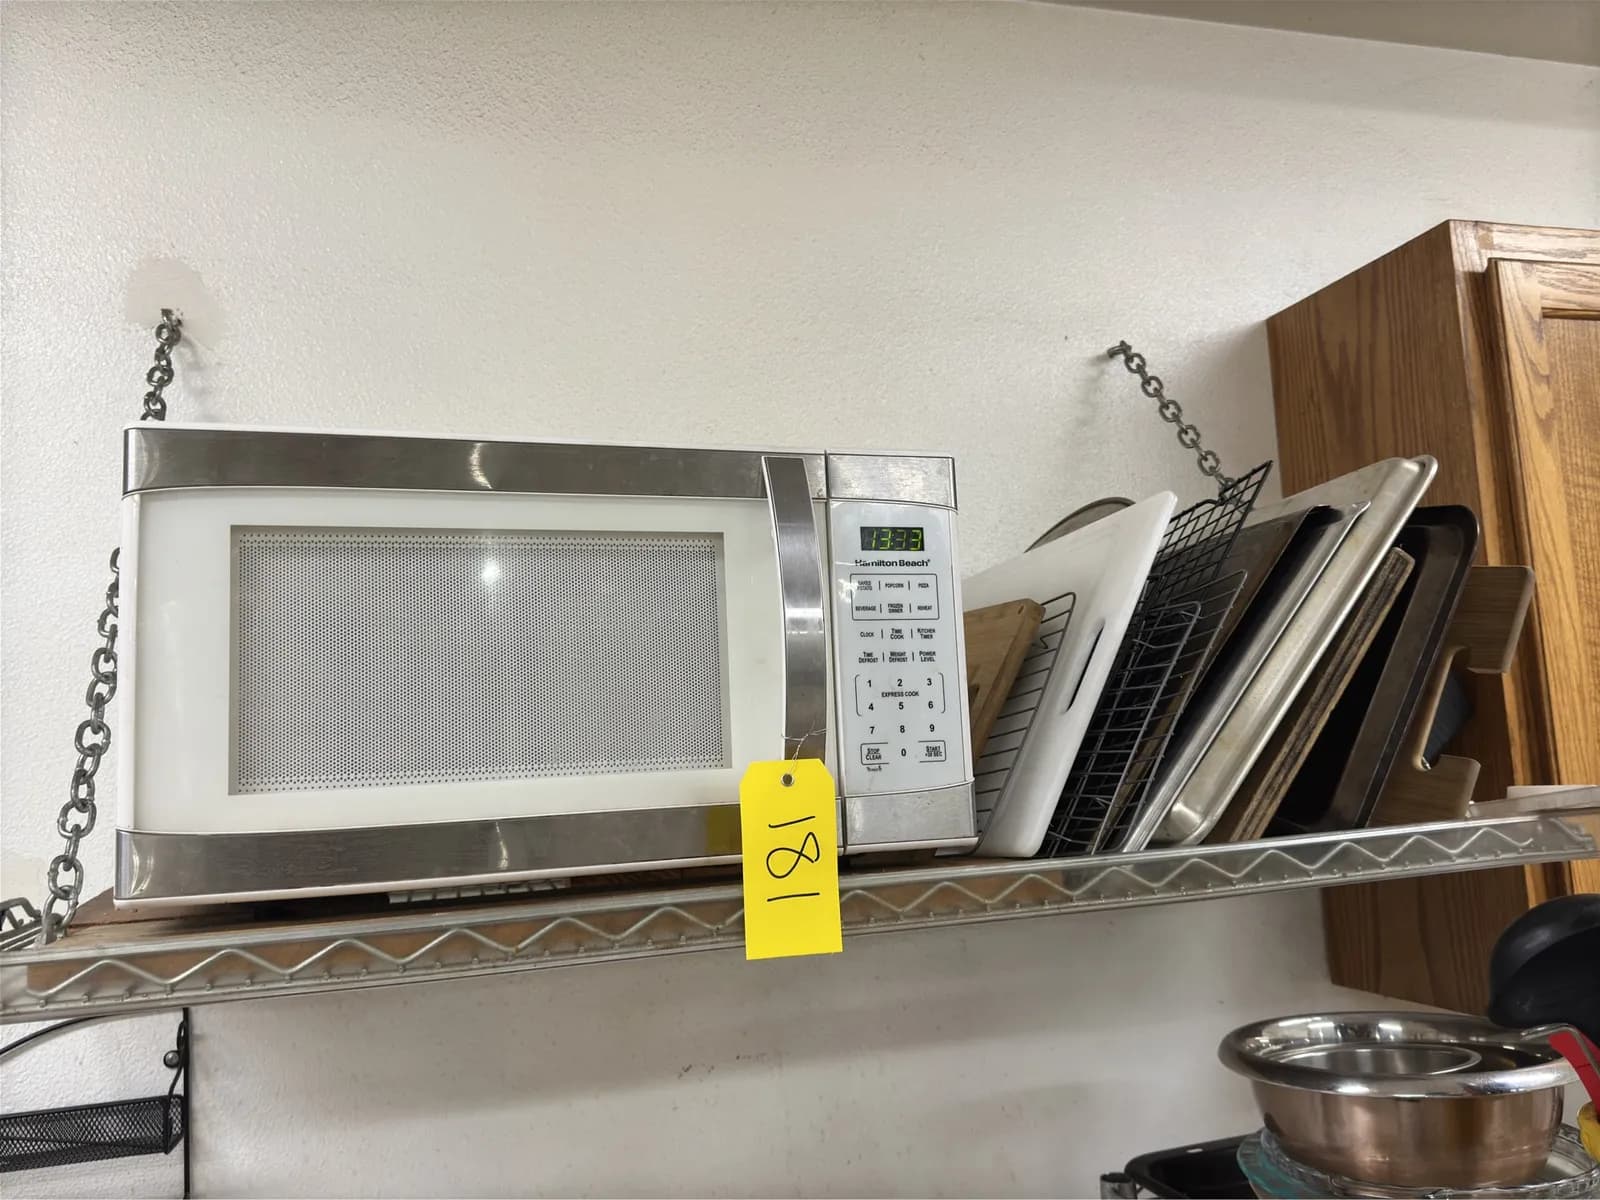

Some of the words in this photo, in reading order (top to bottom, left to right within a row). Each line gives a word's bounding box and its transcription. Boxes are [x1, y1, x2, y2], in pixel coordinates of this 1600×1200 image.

[855, 559, 898, 567] Hamilton
[899, 559, 929, 567] Beach
[867, 679, 872, 687] 1
[897, 678, 903, 687] 2
[927, 678, 932, 686] 3
[868, 703, 874, 711] 4
[898, 702, 904, 710] 5
[928, 701, 934, 709] 6
[870, 726, 875, 734] 7
[900, 725, 905, 733] 8
[929, 724, 935, 732] 9
[900, 748, 907, 756] 0
[767, 815, 820, 902] 181
